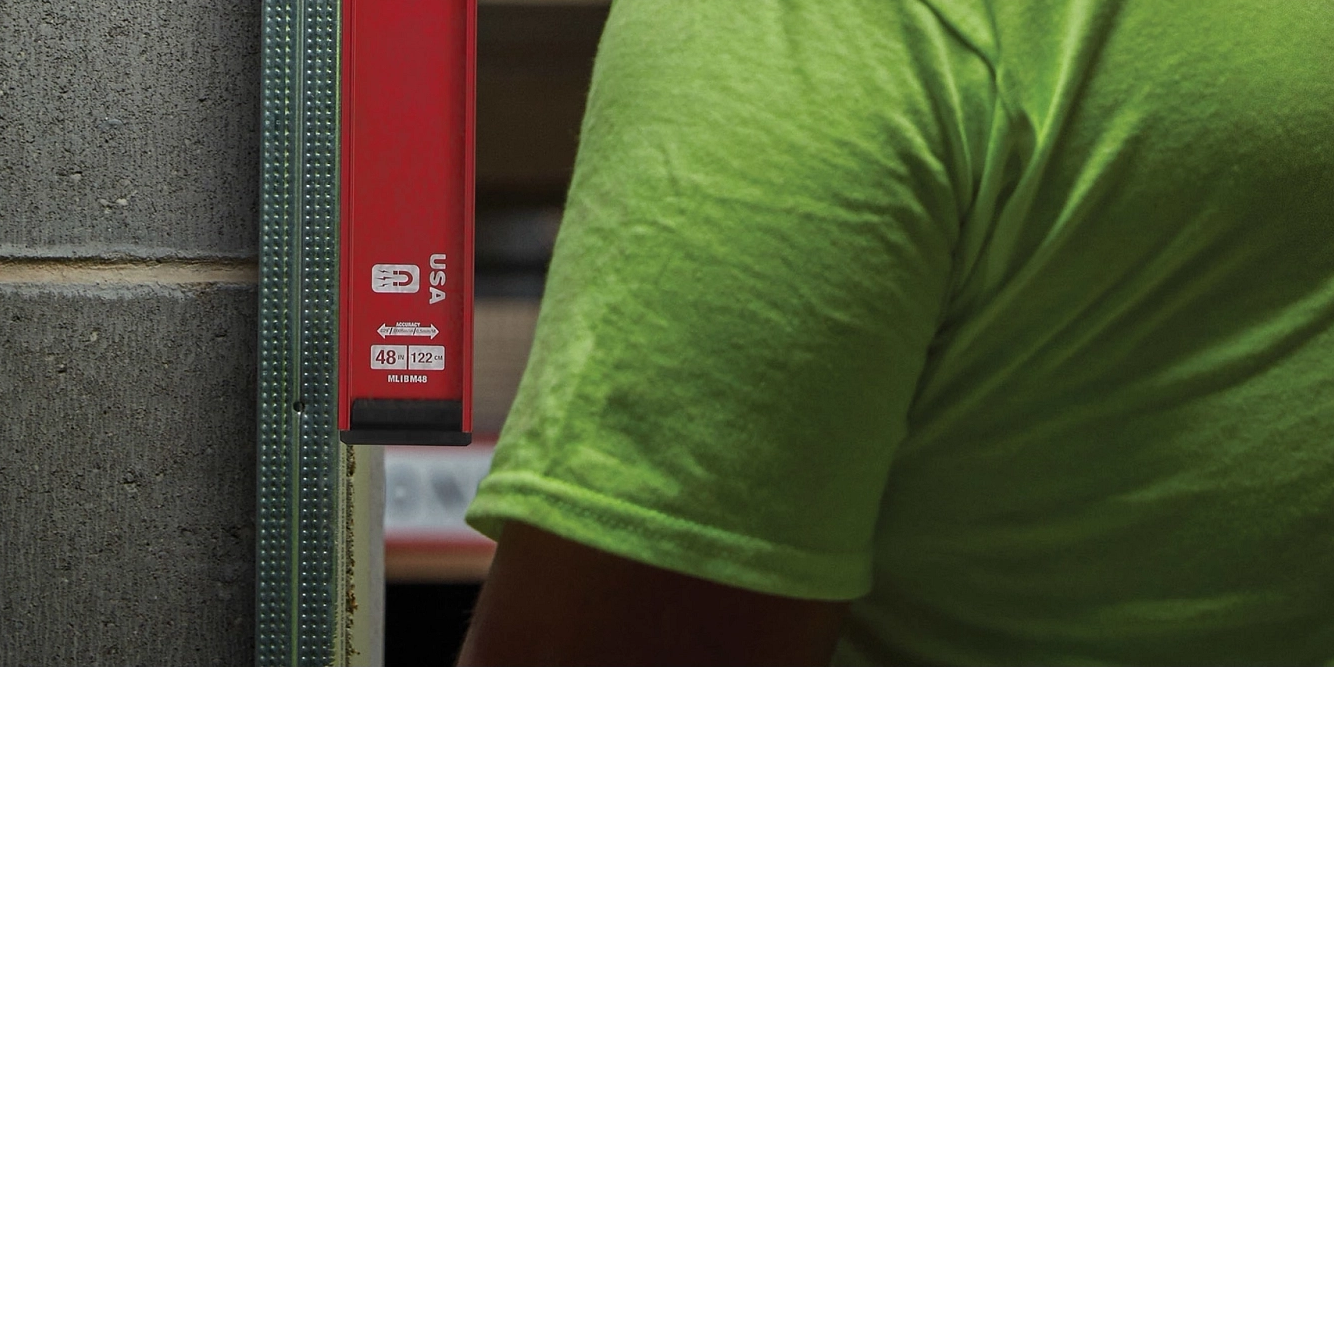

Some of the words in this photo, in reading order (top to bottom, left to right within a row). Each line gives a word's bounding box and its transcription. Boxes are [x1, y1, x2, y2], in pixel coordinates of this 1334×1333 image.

[429, 253, 447, 304] USA
[375, 350, 396, 365] 48
[410, 352, 433, 363] 122
